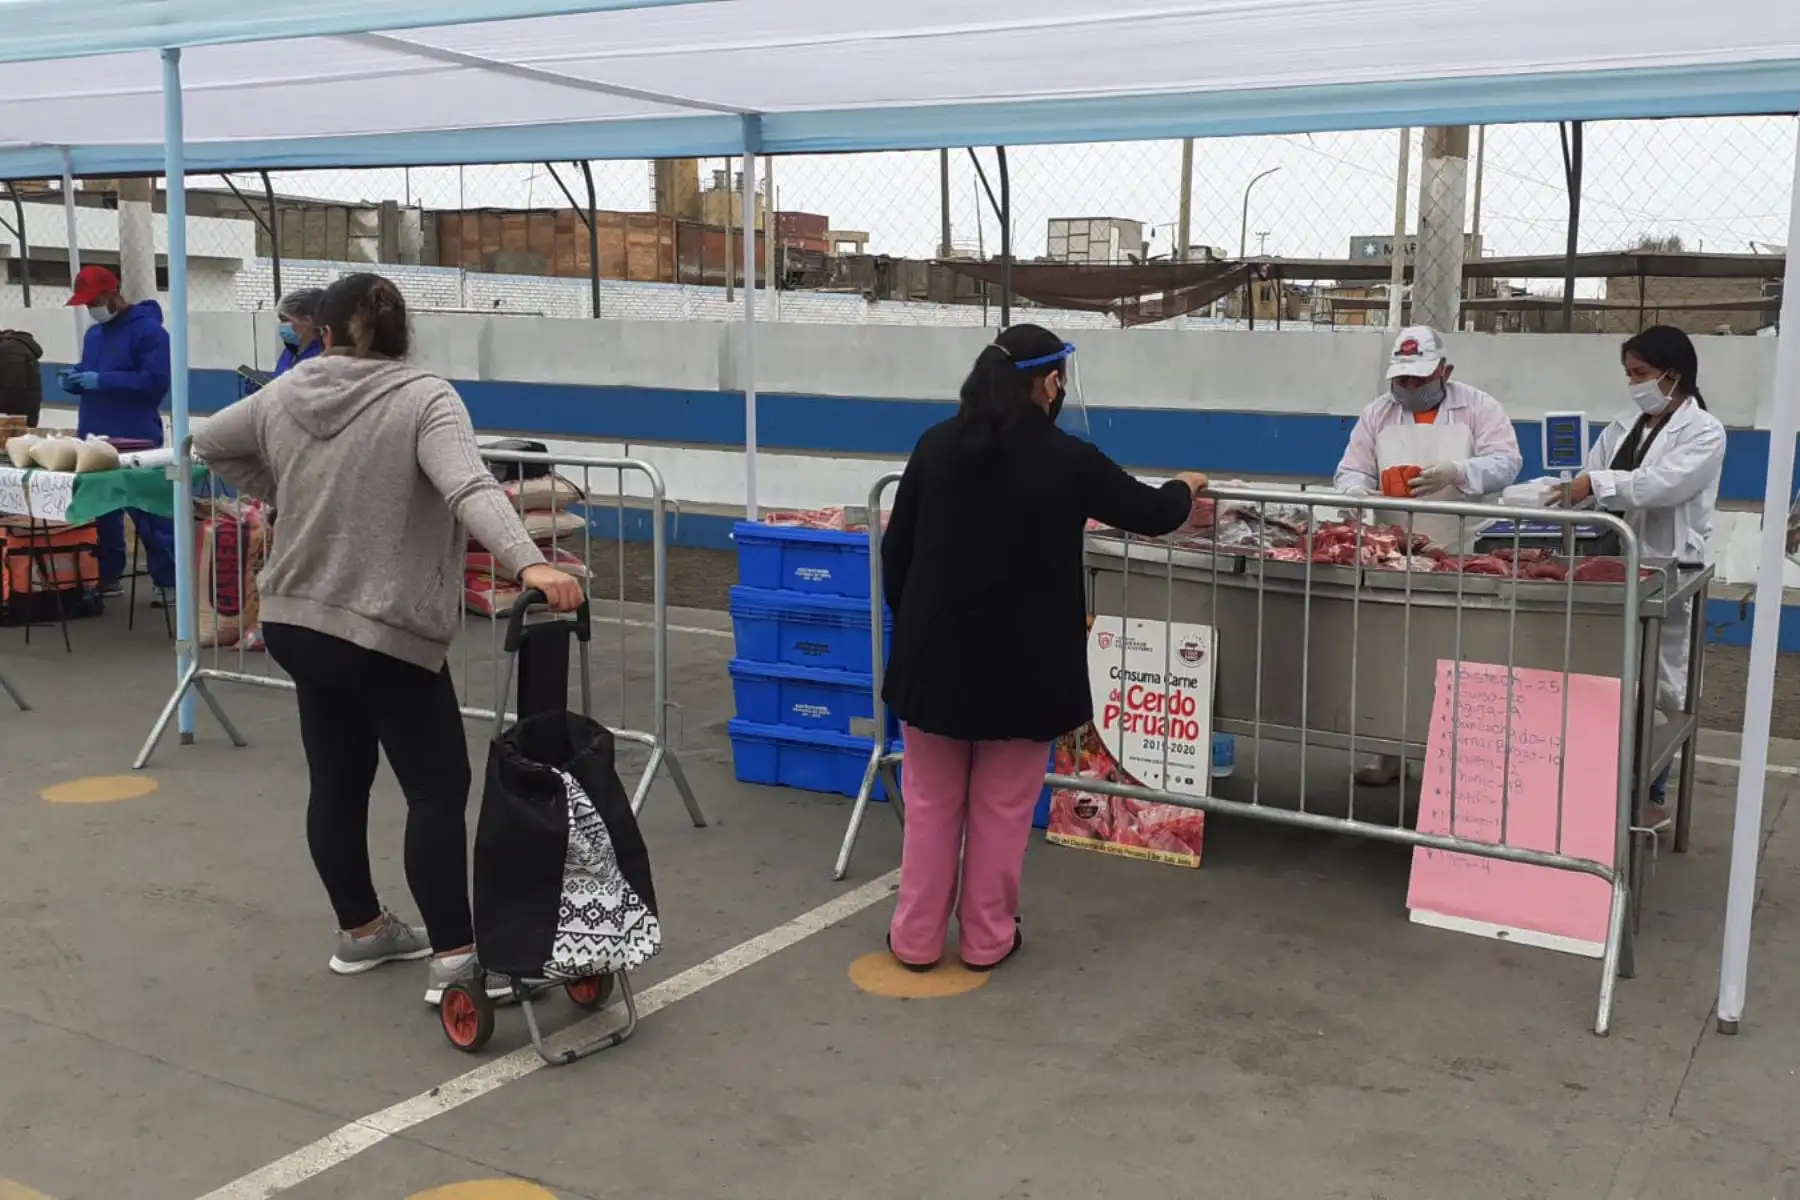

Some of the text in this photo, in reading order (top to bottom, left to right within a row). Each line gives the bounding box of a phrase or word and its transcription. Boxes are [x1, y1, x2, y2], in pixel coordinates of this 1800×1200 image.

[1109, 666, 1198, 689] Consuma Carne
[1127, 684, 1196, 717] Cerdo
[1103, 704, 1199, 741] Peruano
[1143, 739, 1196, 756] 201-2020
